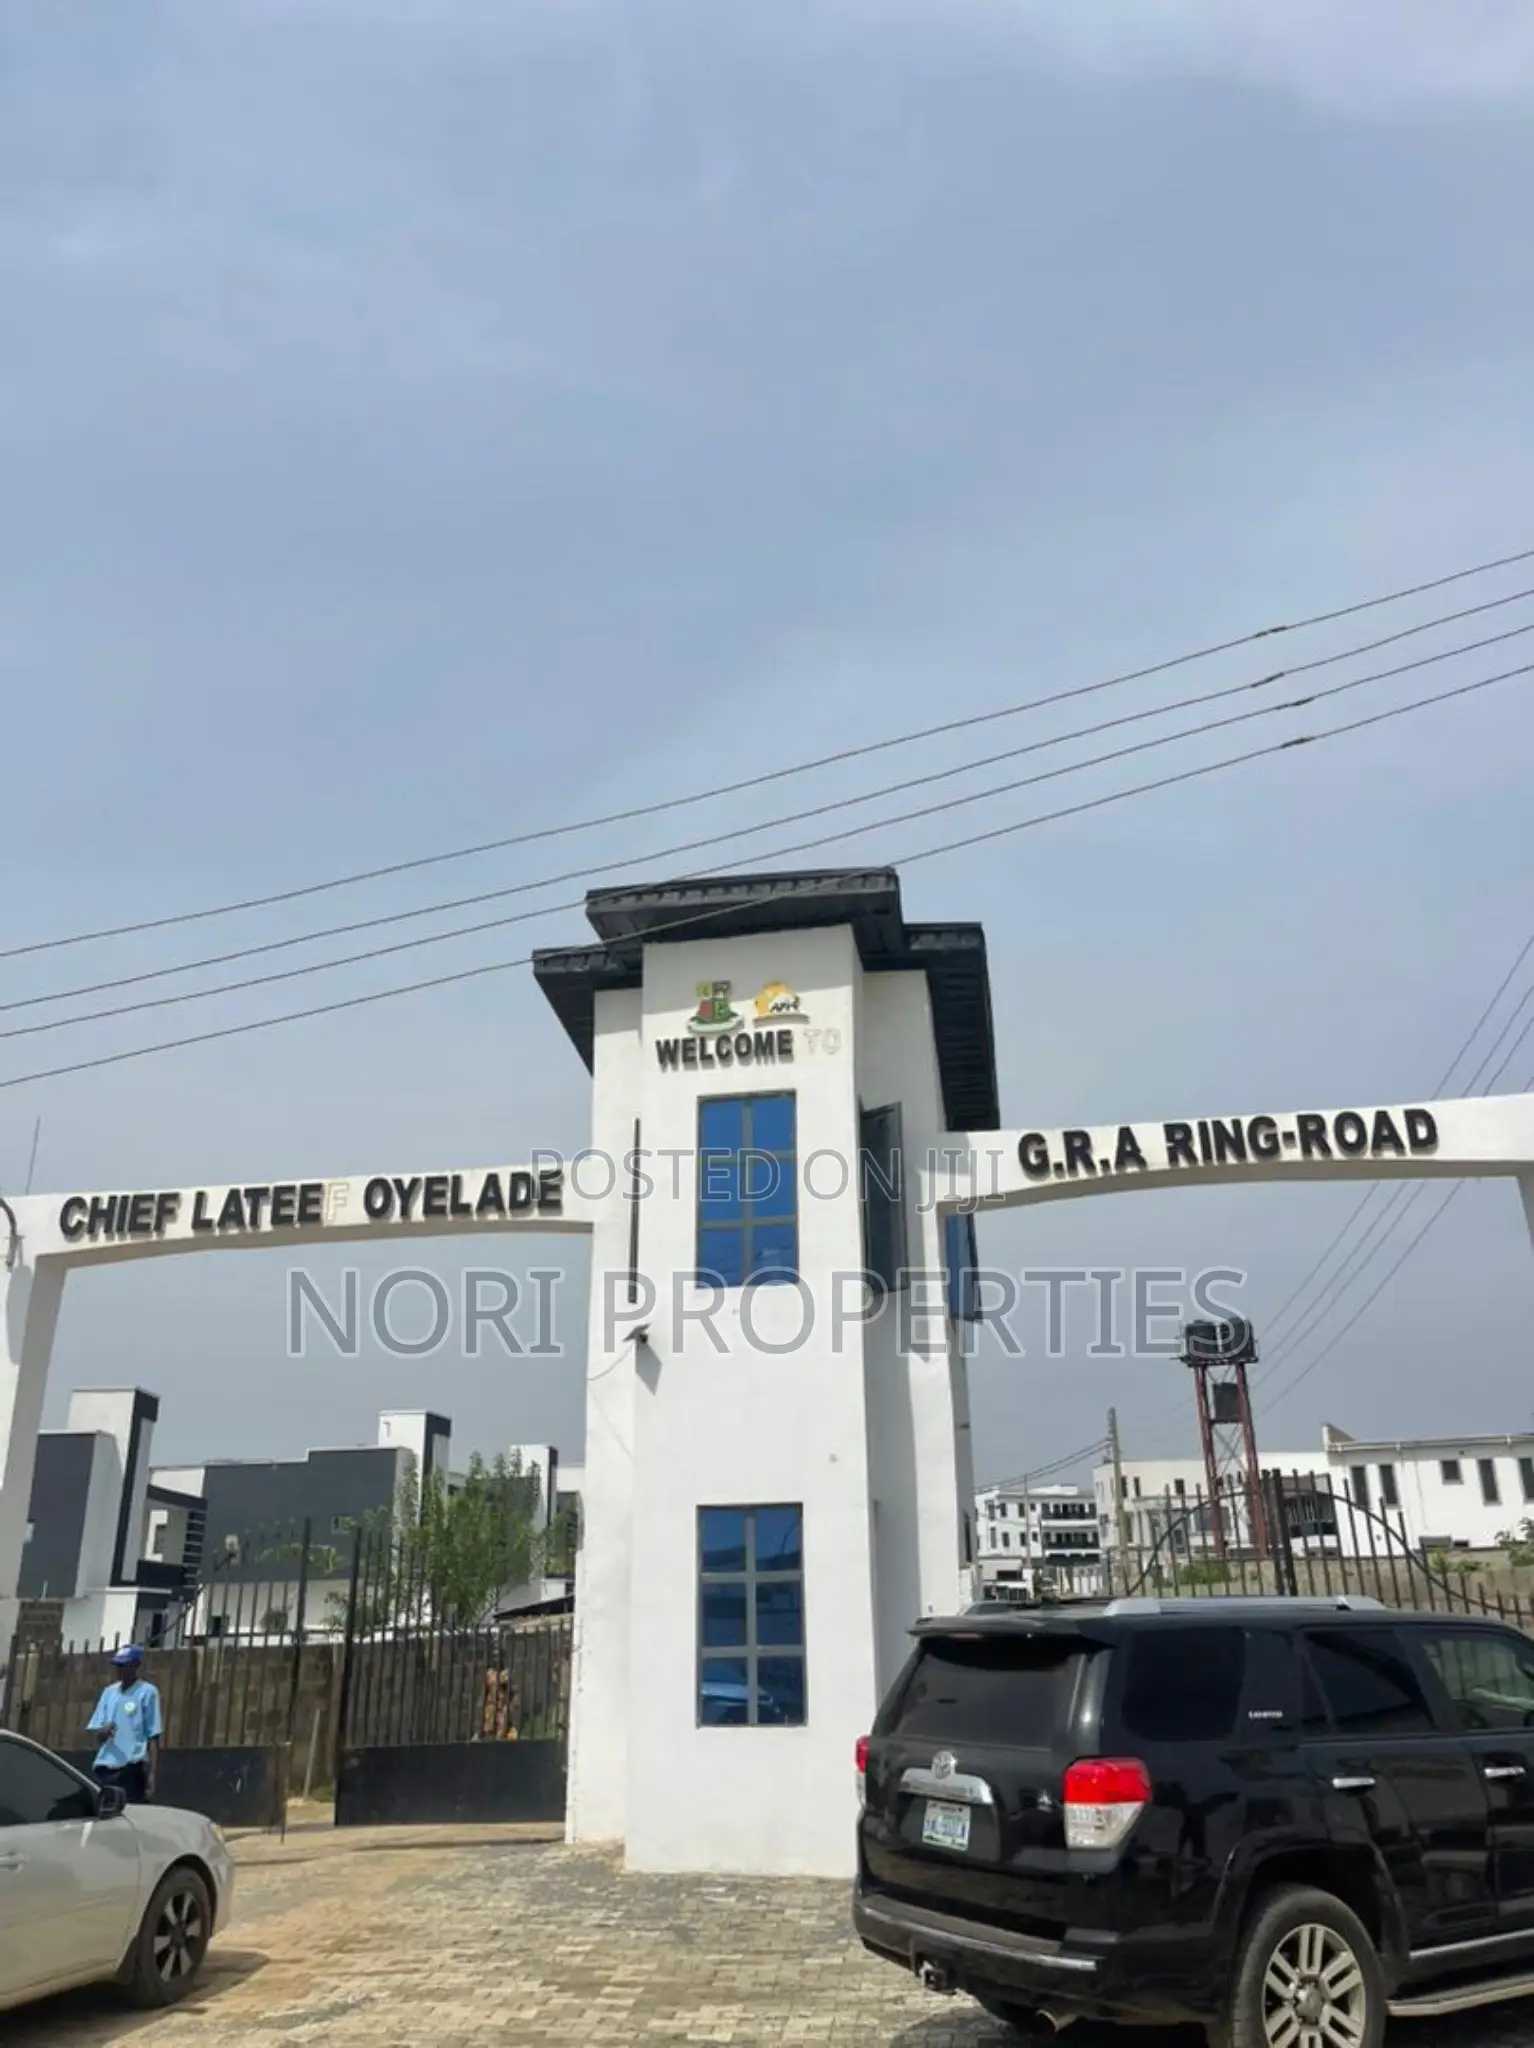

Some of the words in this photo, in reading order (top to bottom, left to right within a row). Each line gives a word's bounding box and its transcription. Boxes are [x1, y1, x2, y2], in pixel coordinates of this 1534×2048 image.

[656, 1029, 794, 1070] WELCOME
[803, 1027, 842, 1055] TO
[1018, 1126, 1147, 1178] G.R.A
[1163, 1108, 1439, 1170] RING-ROAD
[59, 1192, 181, 1240] CHIEF
[363, 1168, 566, 1219] OYELADE
